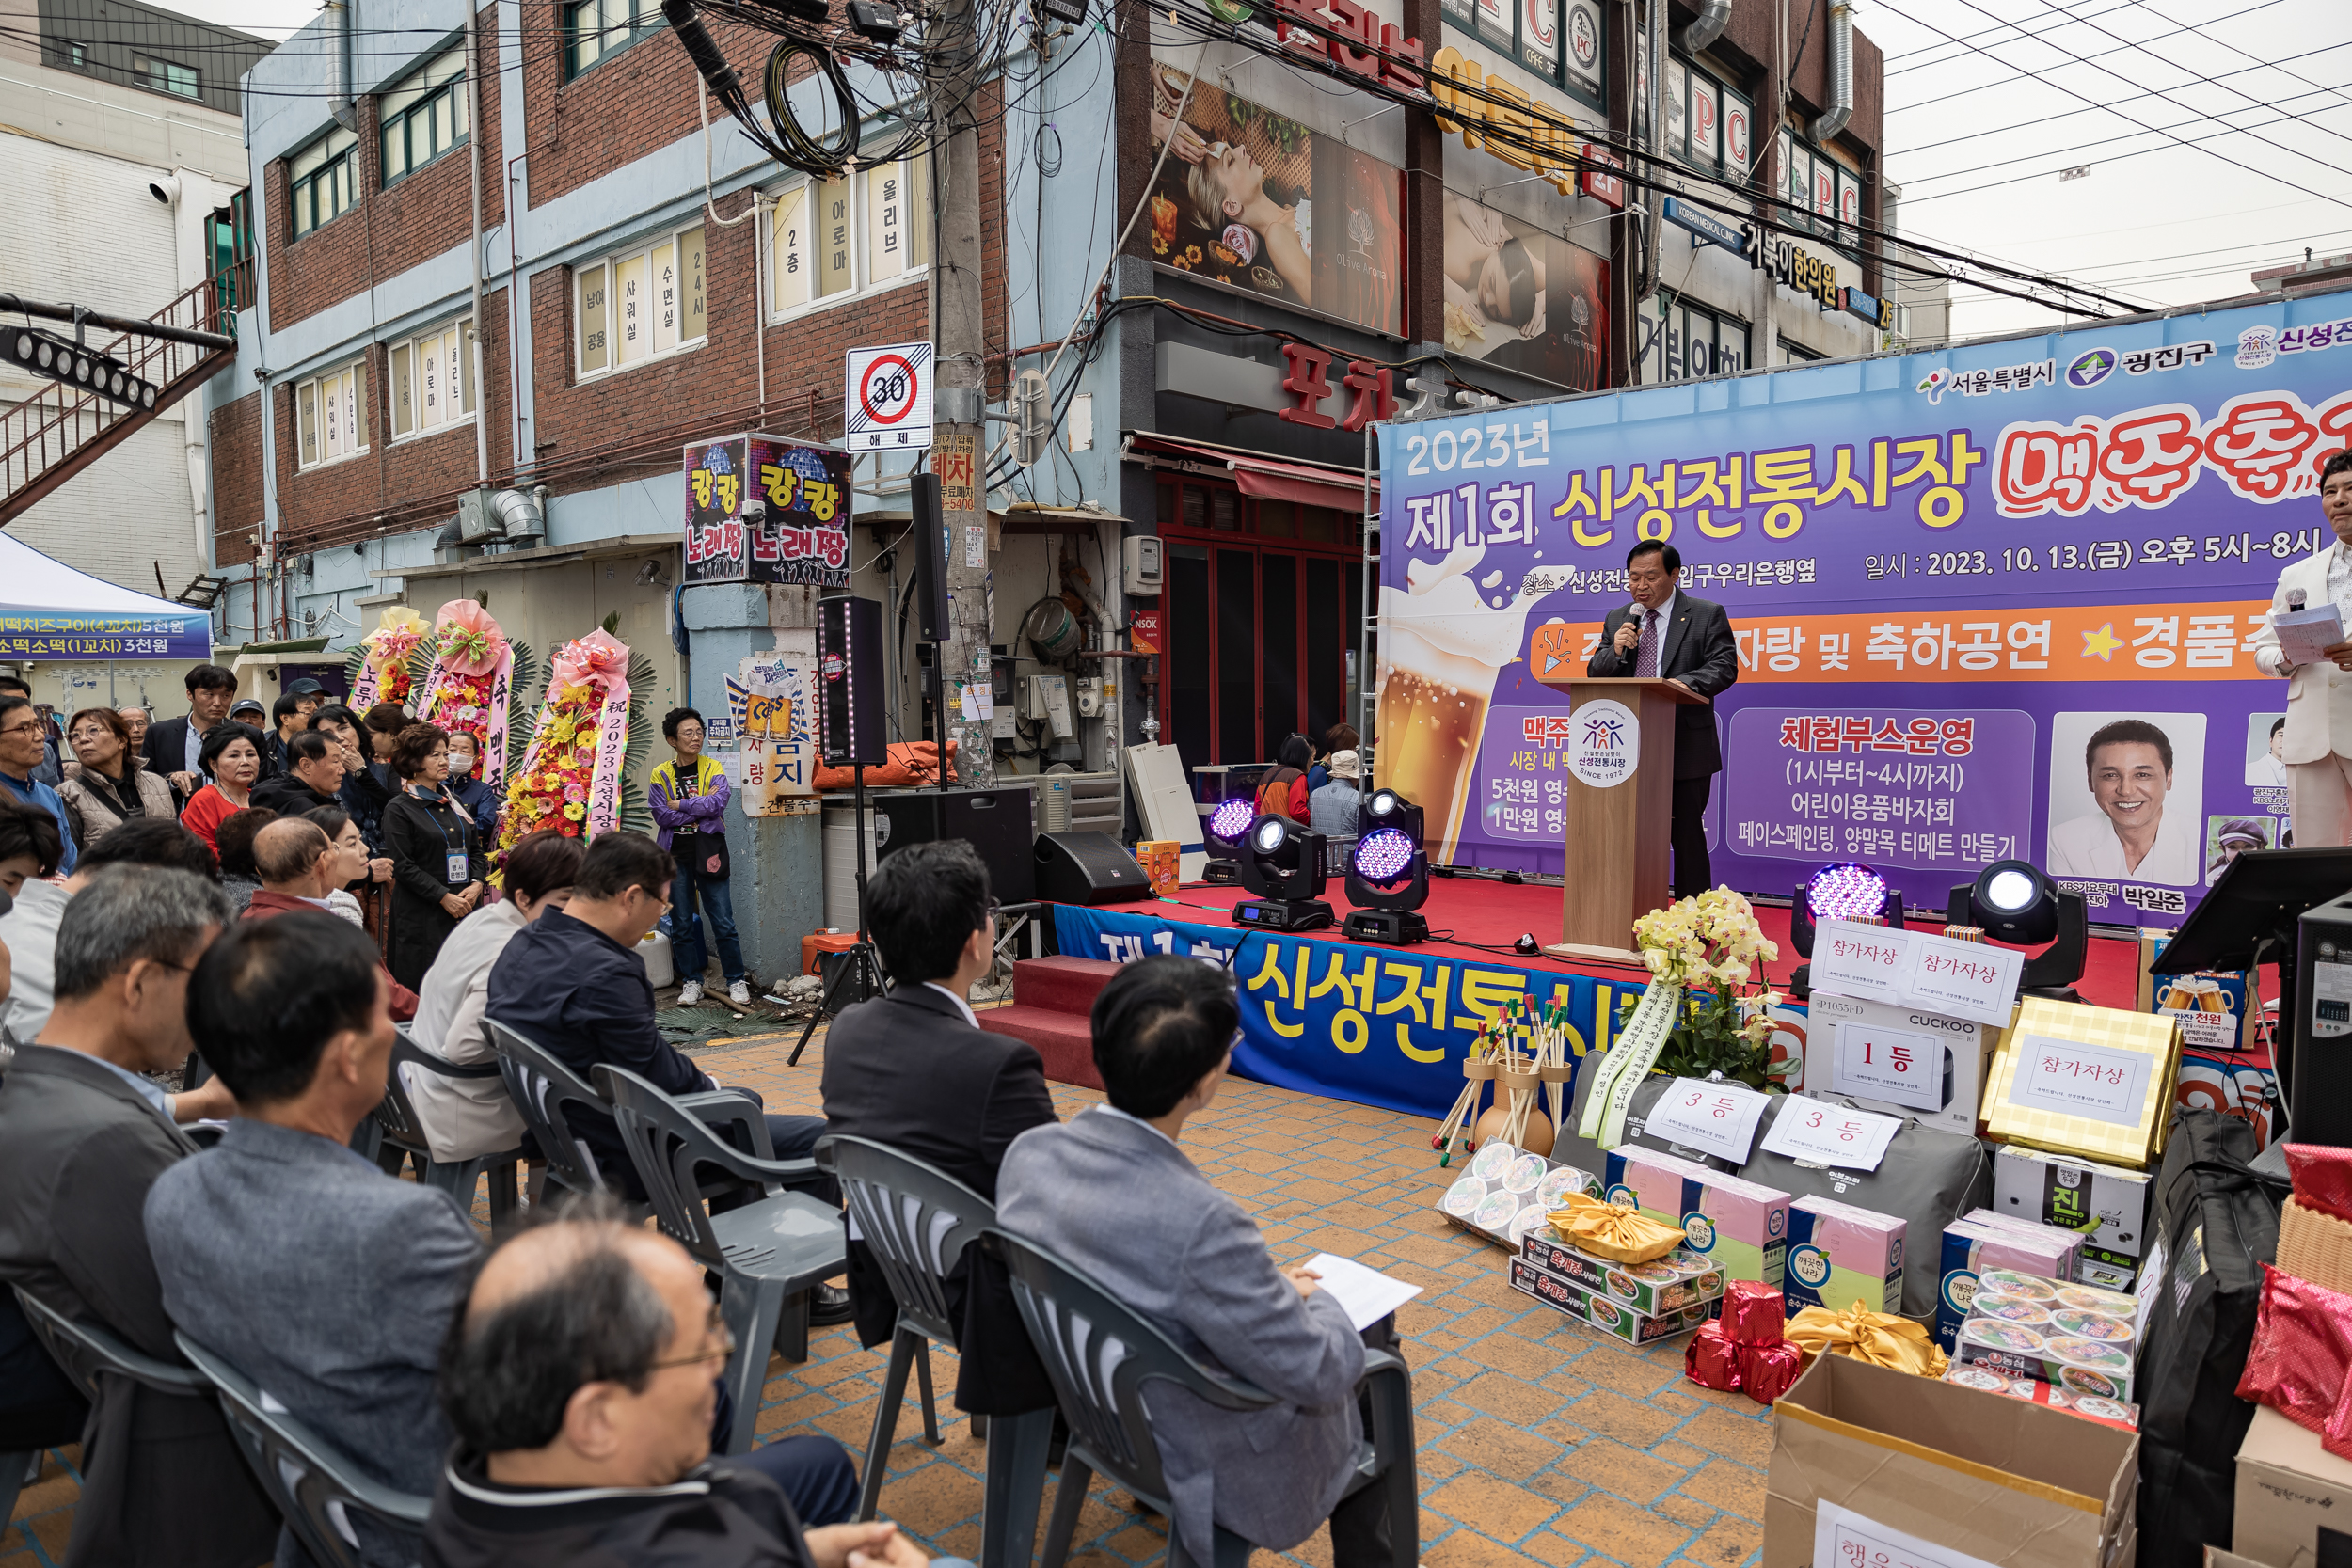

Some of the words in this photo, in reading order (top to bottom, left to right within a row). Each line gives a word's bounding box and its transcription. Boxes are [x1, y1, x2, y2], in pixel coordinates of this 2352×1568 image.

[1576, 34, 1591, 58] PC
[1526, 49, 1543, 71] CAFE
[1546, 61, 1557, 78] 3F
[883, 179, 897, 254] 올리브
[1677, 204, 1700, 227] KOREAN
[1699, 214, 1721, 236] MEDICAL
[1720, 225, 1736, 245] CLINIC
[832, 198, 847, 271] 아로마
[787, 229, 799, 274] 2층
[1336, 252, 1362, 271] Olive
[1362, 261, 1387, 281] Aroma
[662, 265, 674, 328] 수면실
[692, 251, 704, 316] 24시
[586, 288, 604, 310] 남여
[626, 279, 636, 341] 샤워실
[1850, 289, 1876, 316] 456-5030
[1880, 299, 1893, 327] 2F
[587, 330, 605, 352] 공용
[1563, 333, 1581, 346] Olive
[1581, 339, 1597, 354] Aroma
[2122, 341, 2217, 374] 광진구
[426, 356, 435, 407] 아로마
[873, 374, 905, 404] 30
[1279, 342, 1399, 434] 포차
[1951, 361, 2055, 395] 서울특별시
[1406, 419, 1549, 476] 2023년
[1405, 482, 1536, 552] 제1회
[1552, 432, 1982, 548] 신성전통시장
[1865, 552, 1908, 580] 일시
[1926, 550, 1994, 576] 2023.
[2004, 547, 2039, 573] 10.
[2139, 535, 2197, 564] 오후
[2203, 528, 2322, 563] 5시~8시
[1521, 573, 1556, 596] 장소
[1679, 558, 1816, 591] 입구우리은행옆
[1135, 619, 1157, 629] NSOK
[1818, 632, 1850, 672] 및
[1865, 619, 2051, 672] 축하공연
[607, 701, 627, 714] 祝
[603, 718, 622, 768] 2023
[709, 726, 731, 736] 주차금지
[1779, 716, 1975, 757] 체험부스운영
[1509, 750, 1538, 772] 시장
[1542, 750, 1556, 772] 내
[1578, 756, 1626, 768] 신성전통시장
[1580, 768, 1602, 780] SINCE
[1605, 769, 1623, 780] 1972
[1786, 758, 1965, 793] (1시부터~4시까지)
[592, 773, 616, 828] 신성시장
[1492, 778, 1539, 805] 5천원
[1493, 807, 1539, 833] 1만원
[1791, 792, 1955, 827] 어린이용품바자회
[1738, 820, 1839, 854] 페이스페인팅,
[1844, 826, 1897, 857] 양말목
[1901, 831, 1955, 860] 티메트
[1961, 833, 2016, 863] 만들기
[2058, 881, 2118, 895] KBS가요무대
[2124, 886, 2185, 914] 박일준
[1832, 938, 1899, 966] 참가자상
[1923, 953, 1998, 985] 참가자상
[1648, 990, 1675, 1040] 신성전통시장
[1820, 1000, 1864, 1015] P1055FD
[2195, 1012, 2221, 1026] 천원
[1909, 1014, 1975, 1034] CUCKOO
[1966, 1035, 1975, 1043] 10
[1631, 1039, 1656, 1070] 맥주축제
[1888, 1045, 1914, 1073] 등
[2041, 1055, 2126, 1085] 참가자상
[1613, 1070, 1642, 1112] 축하드립니다
[1711, 1097, 1735, 1118] 등
[1836, 1121, 1864, 1142] 등
[1828, 1170, 1861, 1184] 이브자리
[2060, 1168, 2079, 1180] 맛있는
[1613, 1194, 1634, 1208] 깨끗한
[1689, 1222, 1710, 1238] 깨끗한
[1691, 1234, 1708, 1244] 나라
[1534, 1243, 1549, 1257] 농심
[1550, 1250, 1583, 1276] 육개장
[1797, 1255, 1824, 1270] 깨끗한
[1522, 1268, 1536, 1281] 농심
[1801, 1267, 1821, 1279] 나라
[1536, 1275, 1569, 1301] 육개장
